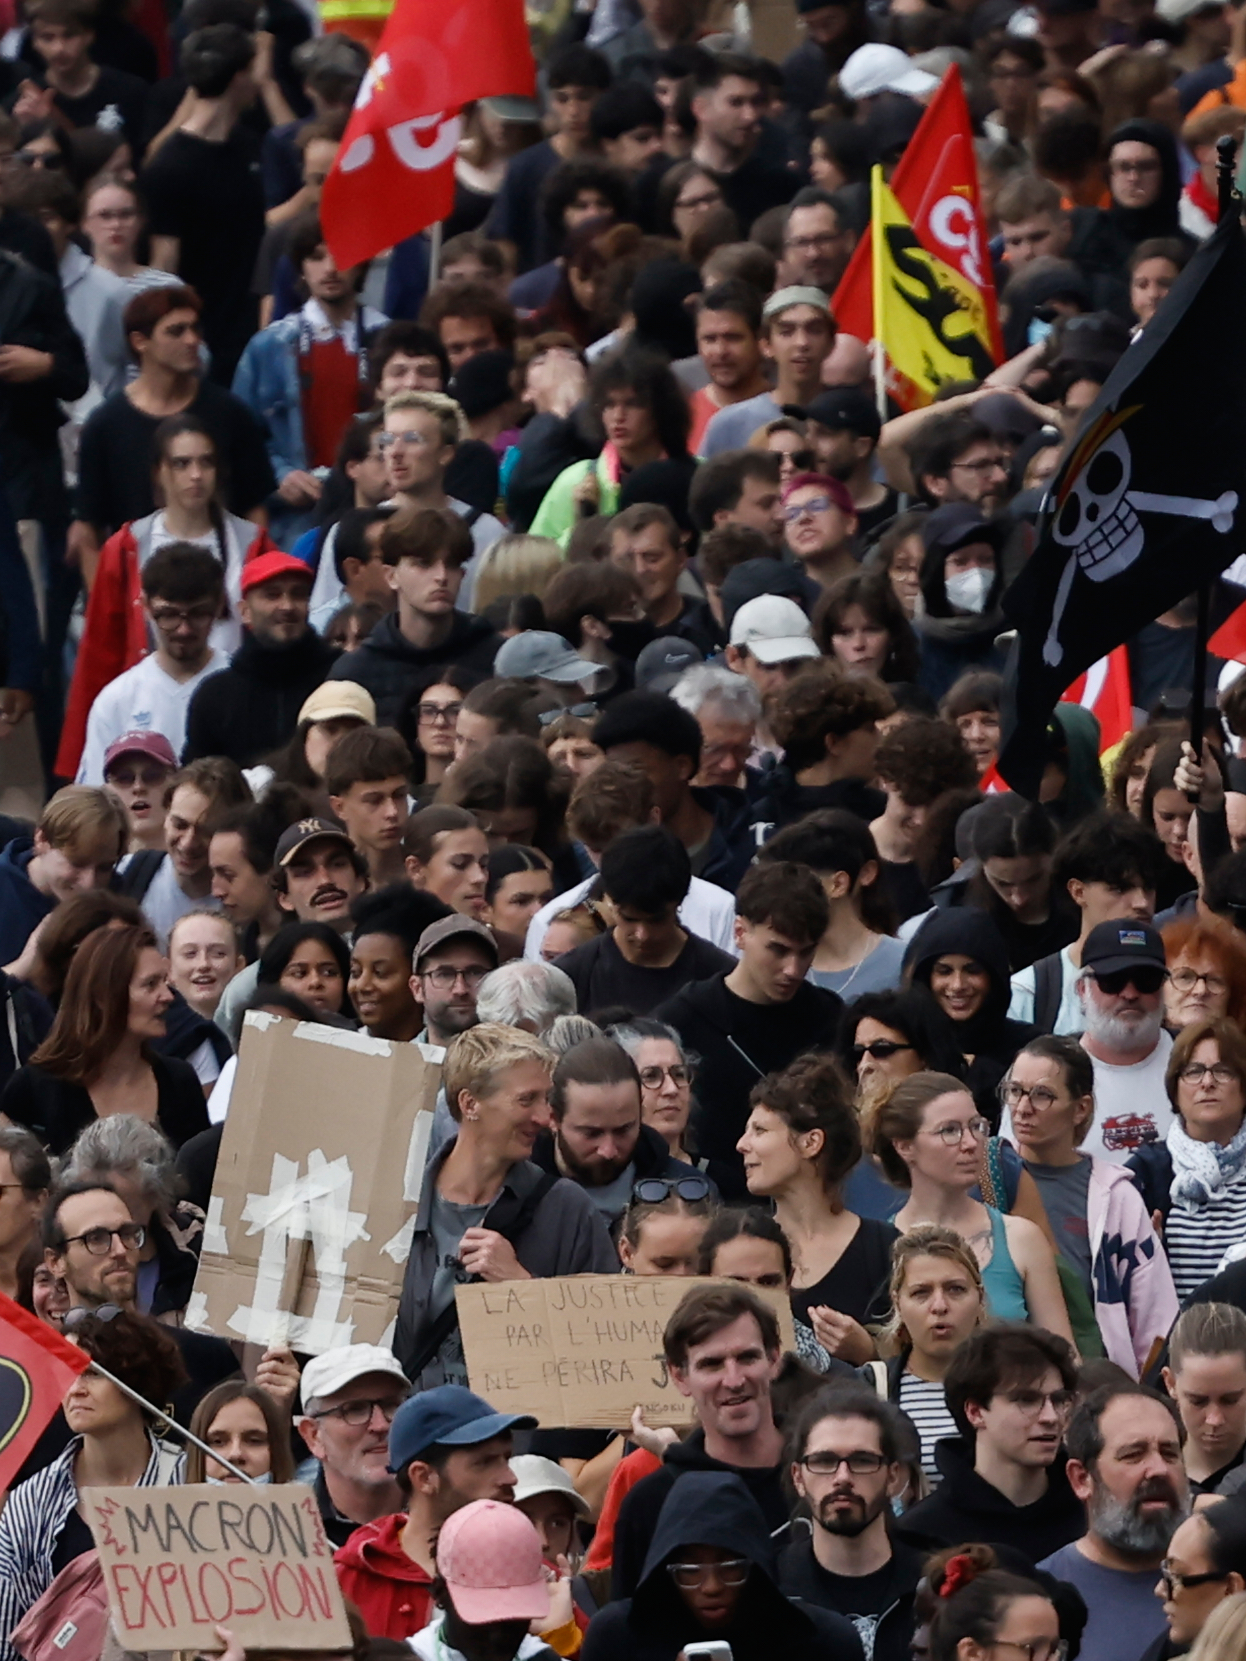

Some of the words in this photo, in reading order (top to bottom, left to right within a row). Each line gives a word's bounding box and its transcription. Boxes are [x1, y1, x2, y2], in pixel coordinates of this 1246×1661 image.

[481, 1287, 525, 1315] LA
[551, 1281, 667, 1311] JUSTICE
[505, 1323, 550, 1348] PAR
[485, 1372, 521, 1393] NE
[125, 1501, 308, 1558] MACRON
